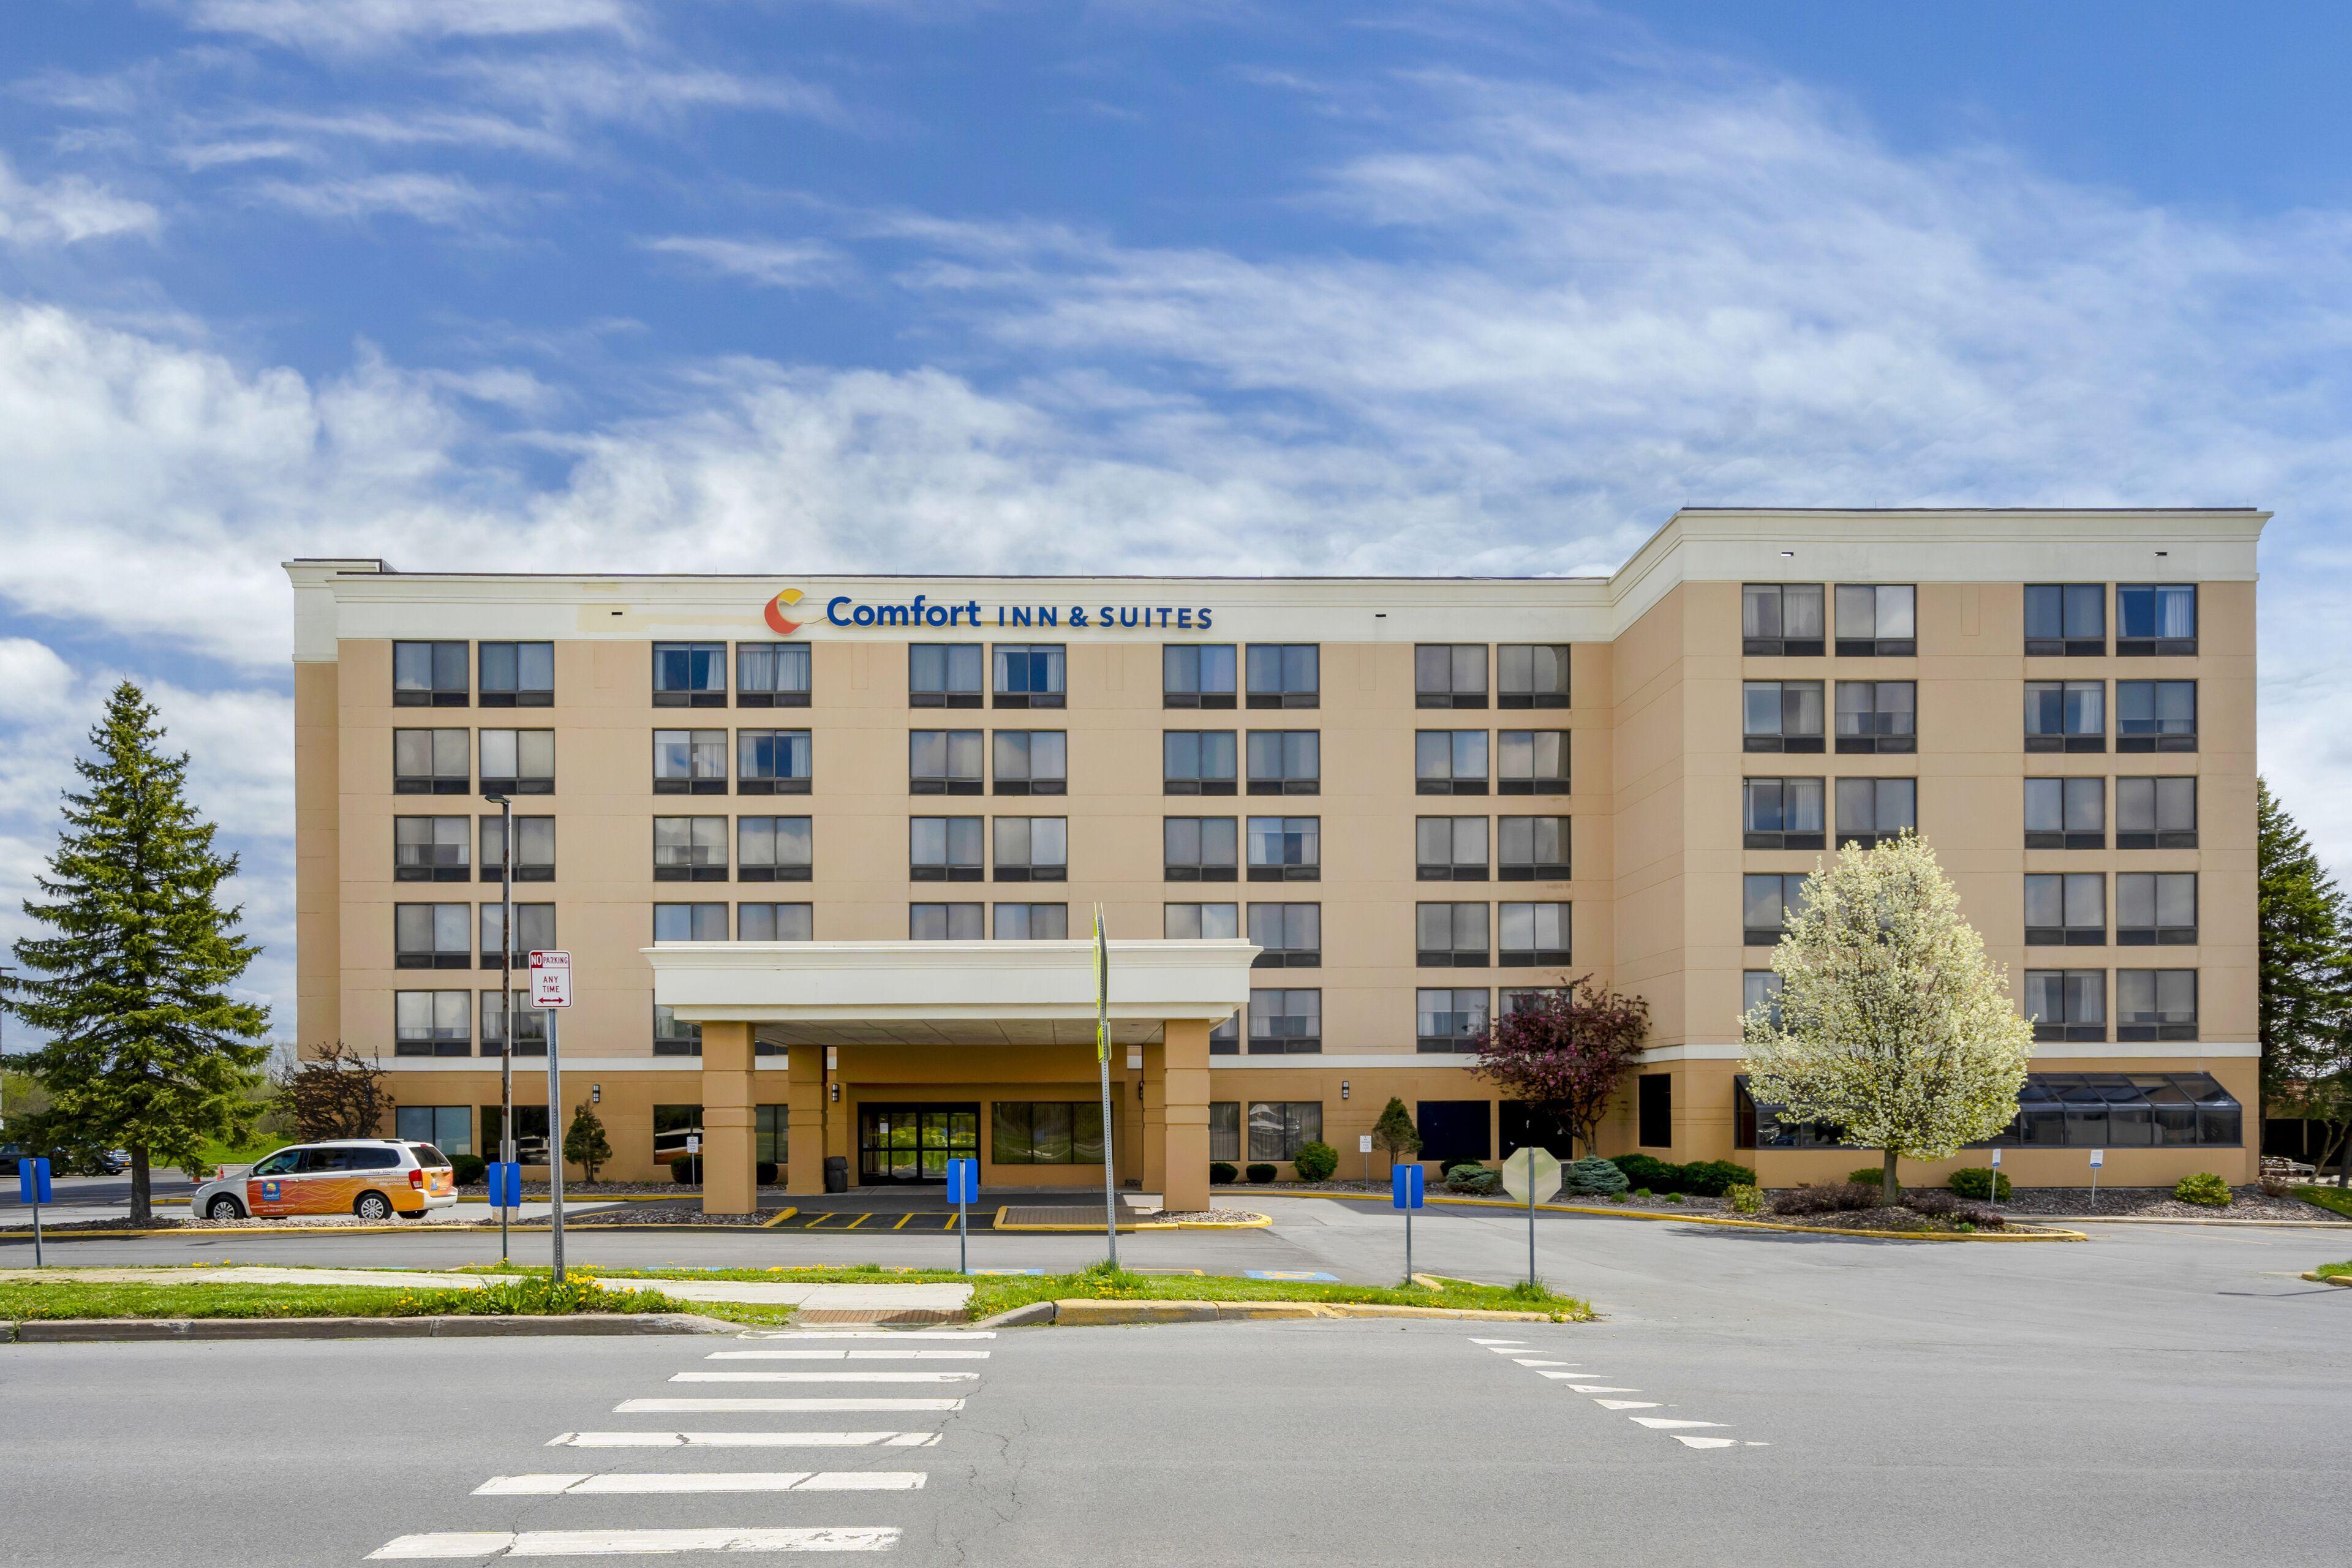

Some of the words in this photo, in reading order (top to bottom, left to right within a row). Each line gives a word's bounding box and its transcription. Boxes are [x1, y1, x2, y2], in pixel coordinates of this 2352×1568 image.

[826, 595, 981, 627] Comfort
[998, 606, 1058, 627] INN
[1068, 606, 1089, 628] &
[1099, 606, 1213, 630] SUITES
[530, 954, 542, 965] NO
